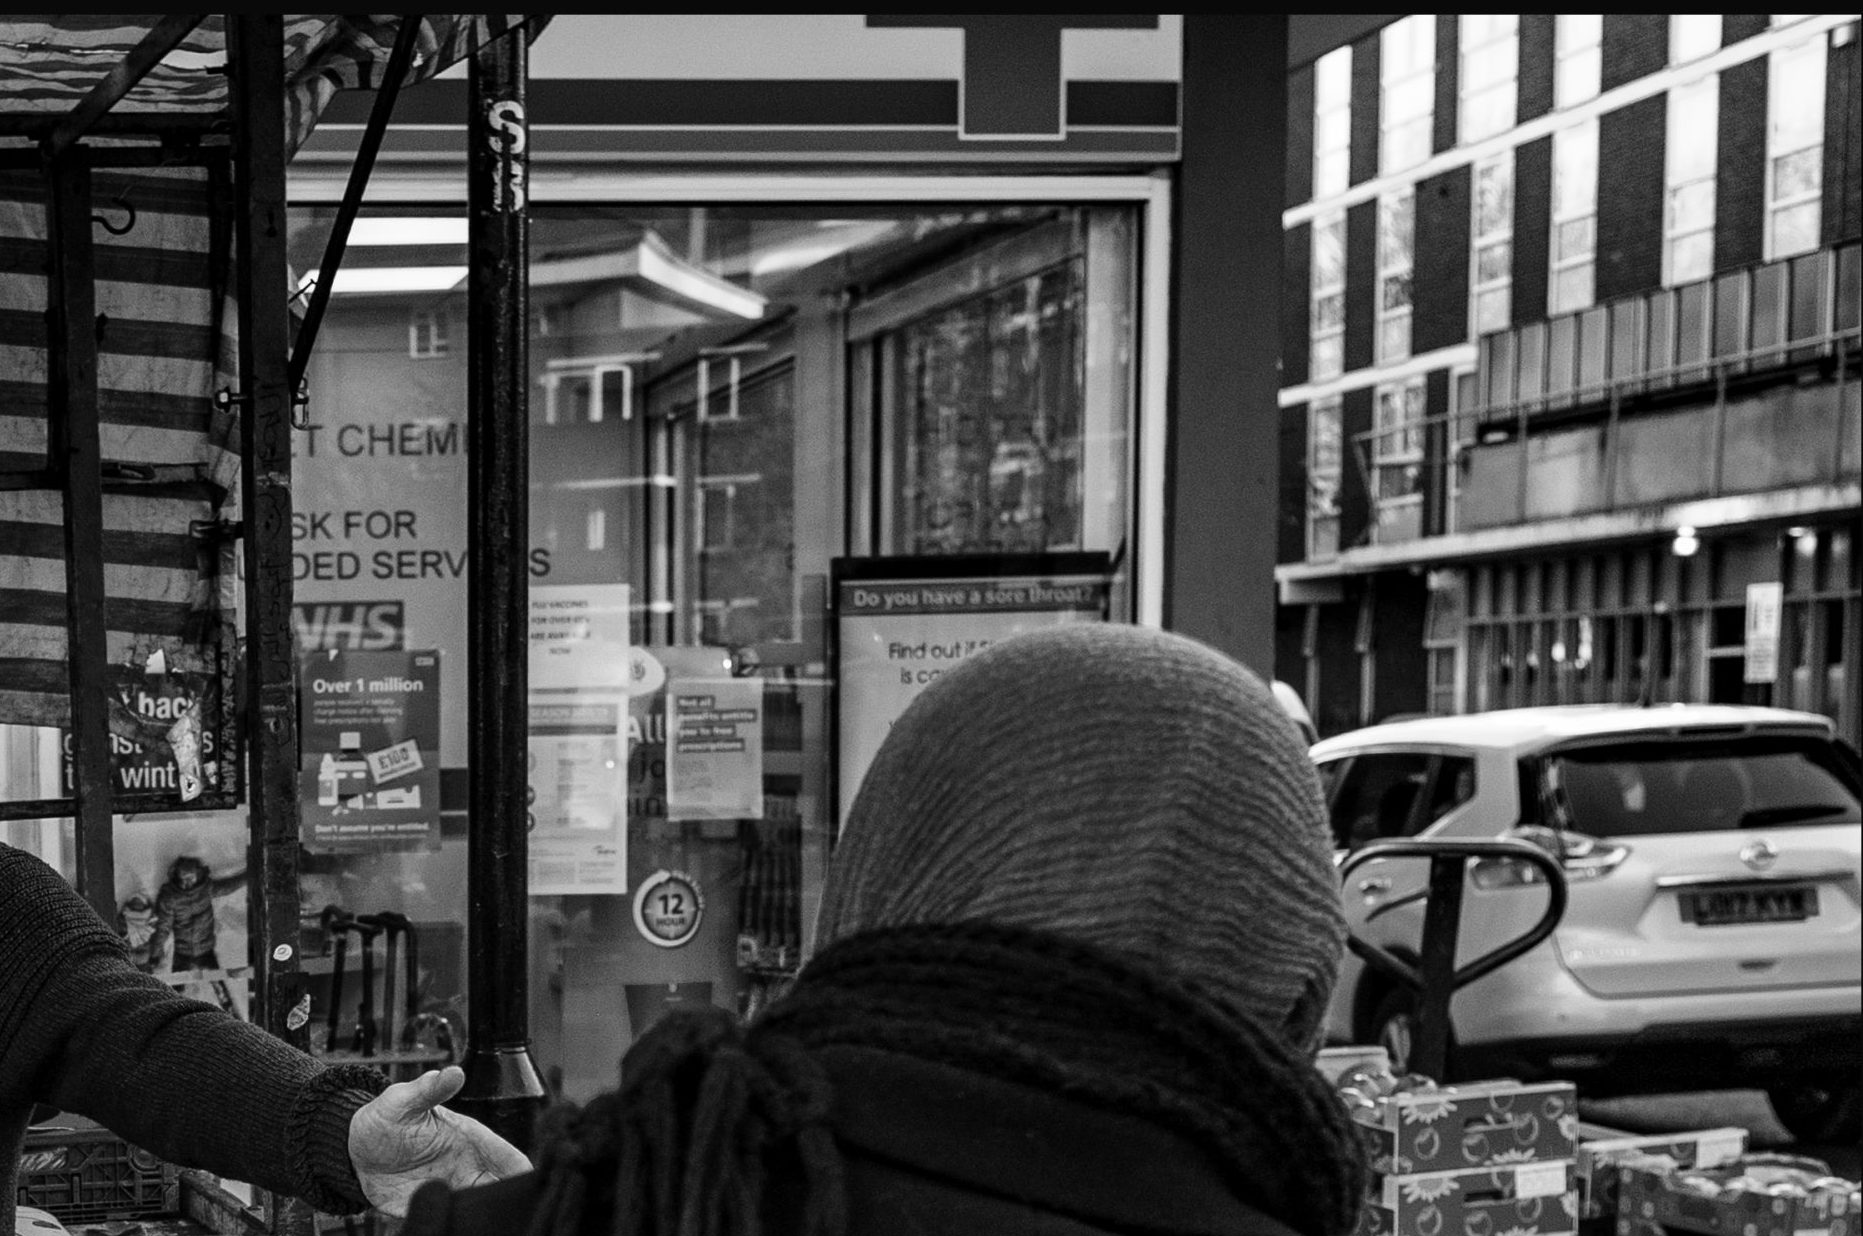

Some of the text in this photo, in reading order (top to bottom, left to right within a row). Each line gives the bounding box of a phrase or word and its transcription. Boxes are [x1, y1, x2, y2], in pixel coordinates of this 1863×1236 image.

[338, 423, 468, 456] CHEM
[292, 510, 417, 540] SK FOR
[372, 547, 551, 580] SERVS
[853, 589, 879, 607] Do
[884, 592, 918, 610] you
[922, 589, 965, 605] have
[969, 592, 980, 604] a
[985, 590, 1026, 604] sore
[289, 604, 399, 649] NHS
[889, 642, 927, 660] Find
[931, 643, 963, 659] out
[313, 676, 424, 694] Over 1 million
[900, 667, 913, 685] is
[138, 691, 196, 720] bac
[120, 760, 186, 790] wint
[658, 893, 684, 916] 12
[655, 916, 686, 927] HOUR
